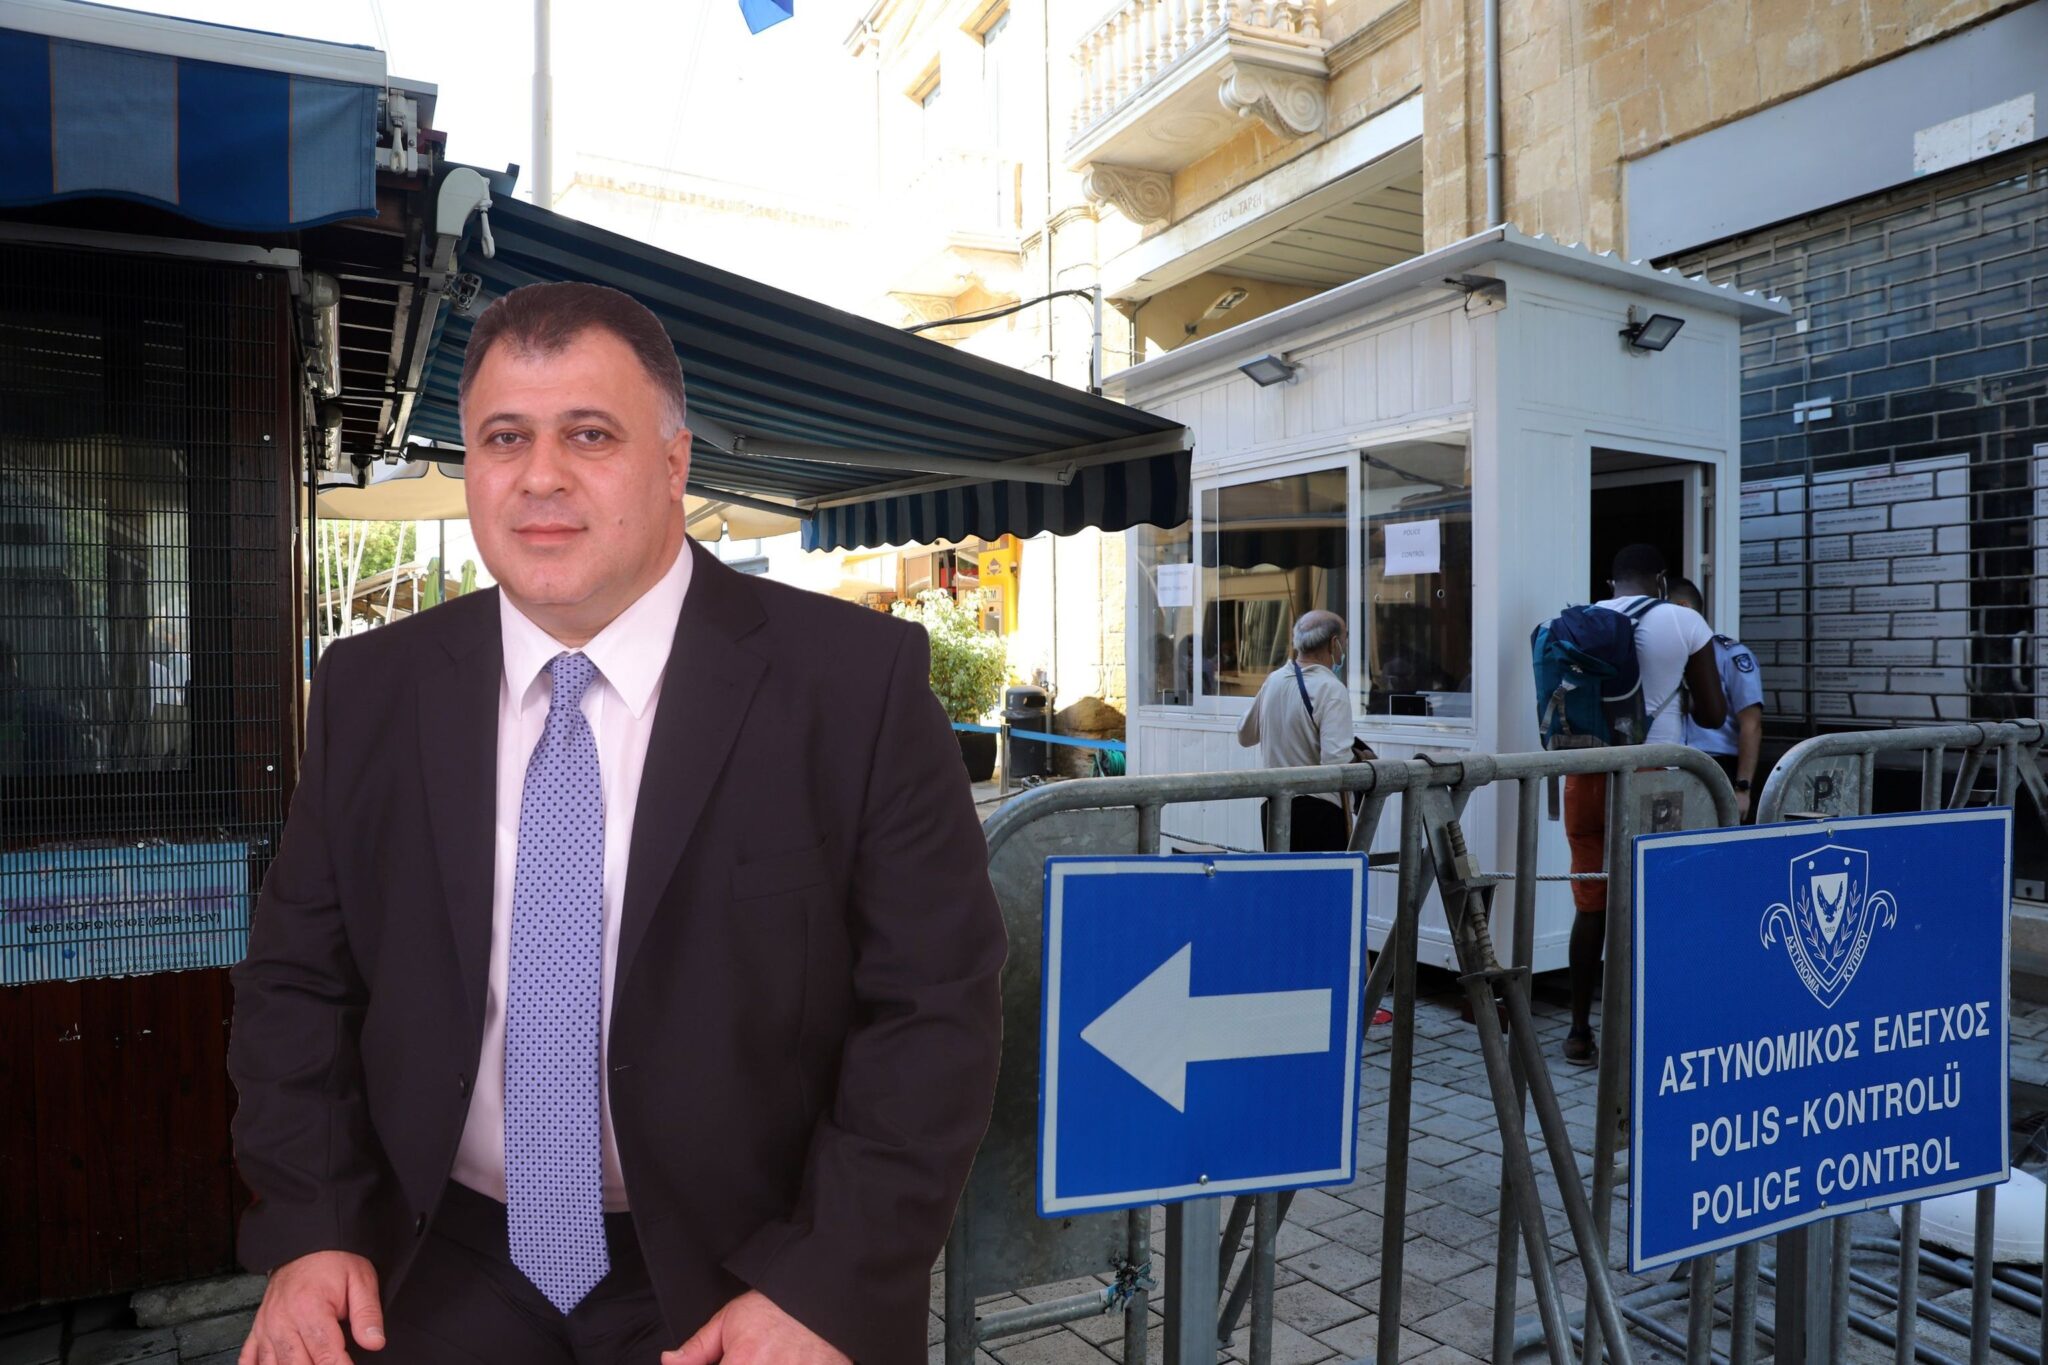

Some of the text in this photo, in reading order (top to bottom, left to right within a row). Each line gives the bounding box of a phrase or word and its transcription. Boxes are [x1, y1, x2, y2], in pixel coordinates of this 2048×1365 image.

[1401, 550, 1425, 559] CONTROL
[1402, 528, 1421, 537] POLICE
[1786, 930, 1868, 995] ΑΣΤΥΝΟΜΙΑ ΚΥΠΡΟΥ
[1659, 1001, 1990, 1096] ΑΣΤΥΝΟΜΙΚΟΣ ΕΛΕΓΧΟΣ
[1692, 1136, 1960, 1230] POLICE CONTROL
